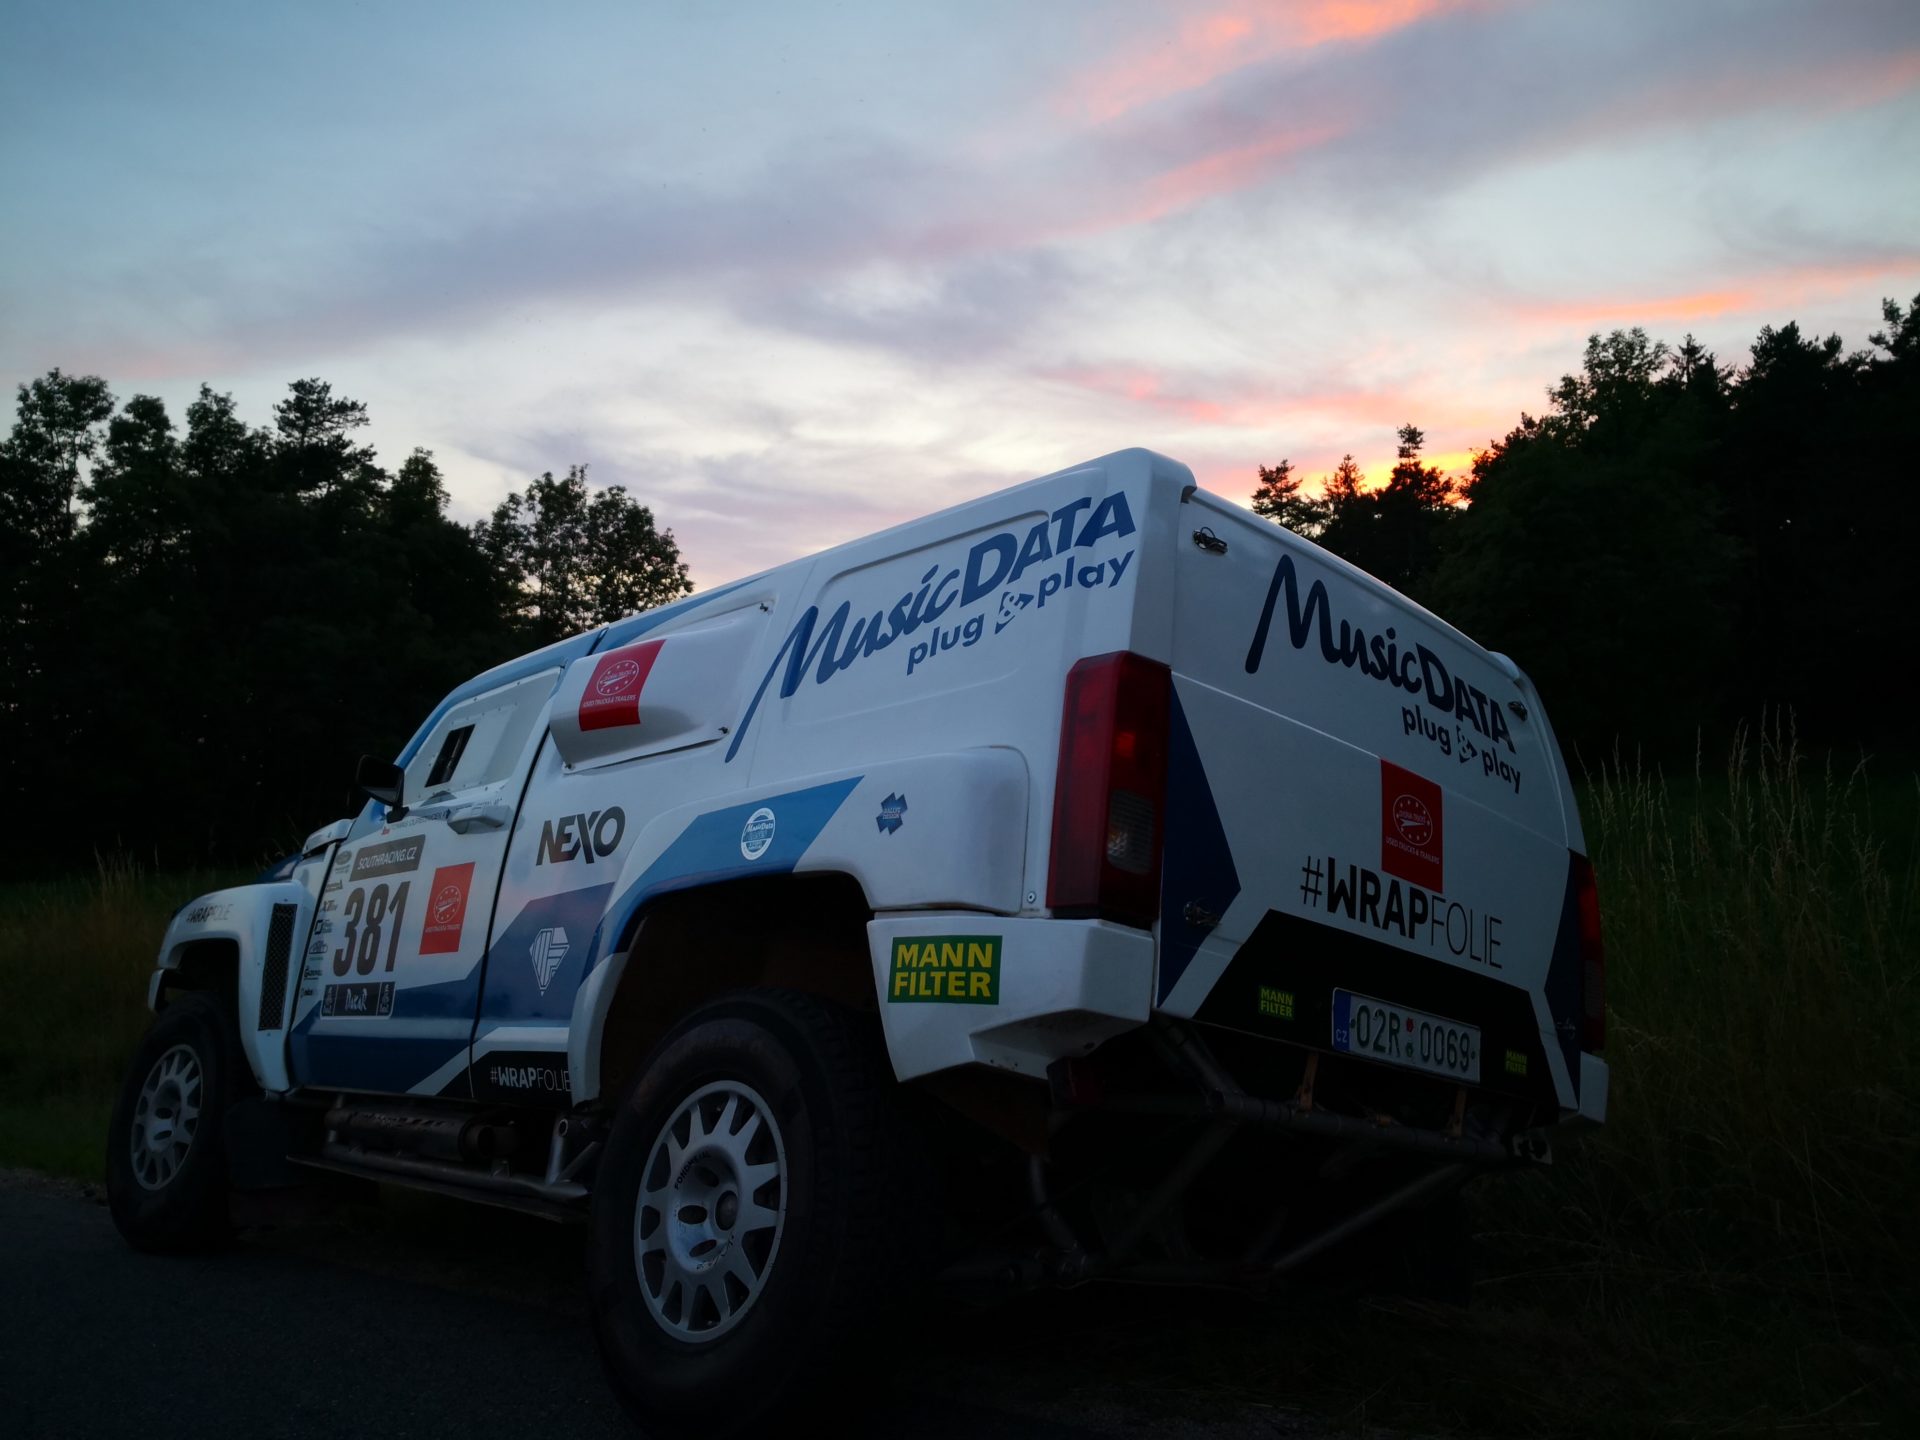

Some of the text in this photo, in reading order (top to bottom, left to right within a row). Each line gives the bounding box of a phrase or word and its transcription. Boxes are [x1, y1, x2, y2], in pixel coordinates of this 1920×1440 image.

[724, 490, 1135, 763] MusicDATA
[906, 612, 984, 675] plug
[1037, 550, 1134, 609] play
[1245, 554, 1516, 754] MusicDATA
[1402, 704, 1451, 755] plug
[1482, 747, 1520, 794] play
[357, 846, 418, 870] SOUTHRACING.CZ
[536, 806, 626, 866] NEXO
[333, 881, 411, 977] 381
[1300, 856, 1503, 969] #WRAPFOLIE
[893, 971, 992, 997] FILTER
[896, 943, 993, 968] MANN
[1260, 988, 1294, 1006] MANN
[1260, 1000, 1293, 1018] FILTER
[1335, 1028, 1348, 1044] CZ
[1356, 1005, 1471, 1073] 02R 0069
[489, 1064, 571, 1092] #WRAPFOLIE
